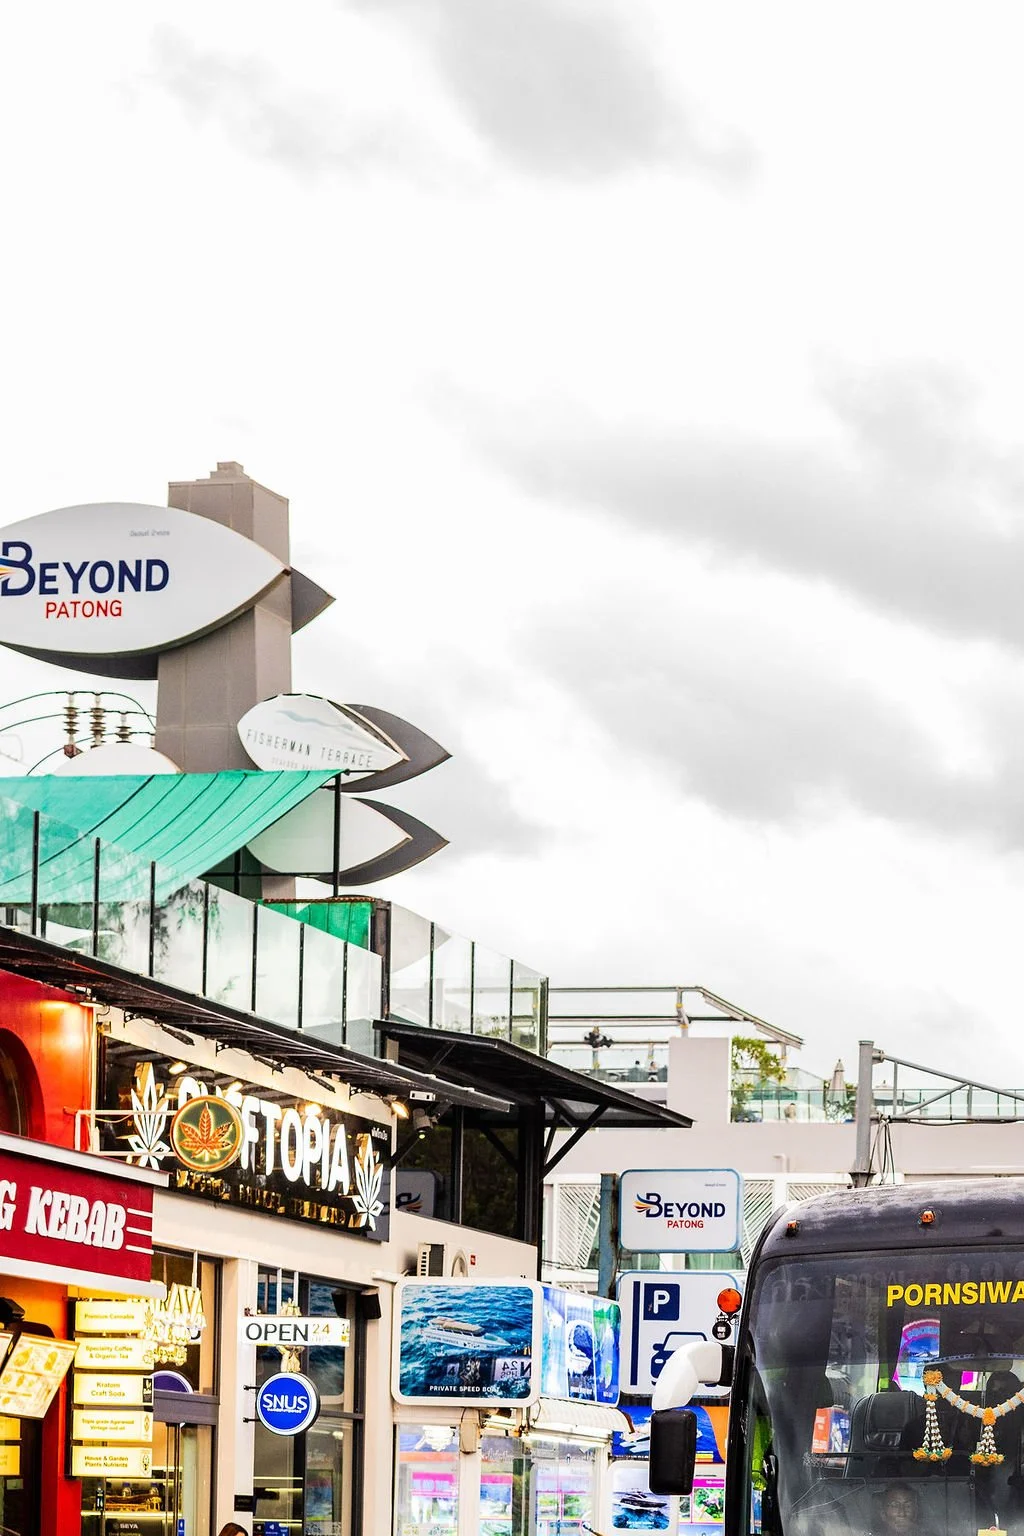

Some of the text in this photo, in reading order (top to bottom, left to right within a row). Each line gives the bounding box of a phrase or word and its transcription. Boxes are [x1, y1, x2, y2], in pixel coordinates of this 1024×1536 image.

[1, 541, 170, 597] BEYOND
[45, 599, 122, 619] PATONG
[246, 728, 374, 769] FISHERMAN TERRACE
[646, 1192, 726, 1218] BEYOND
[24, 1186, 127, 1250] KEBAB
[667, 1220, 704, 1229] PATONG
[653, 1290, 671, 1314] P
[245, 1322, 309, 1342] OPEN
[312, 1323, 331, 1335] 24
[459, 1385, 480, 1393] SPEED
[262, 1393, 308, 1411] SNUS
